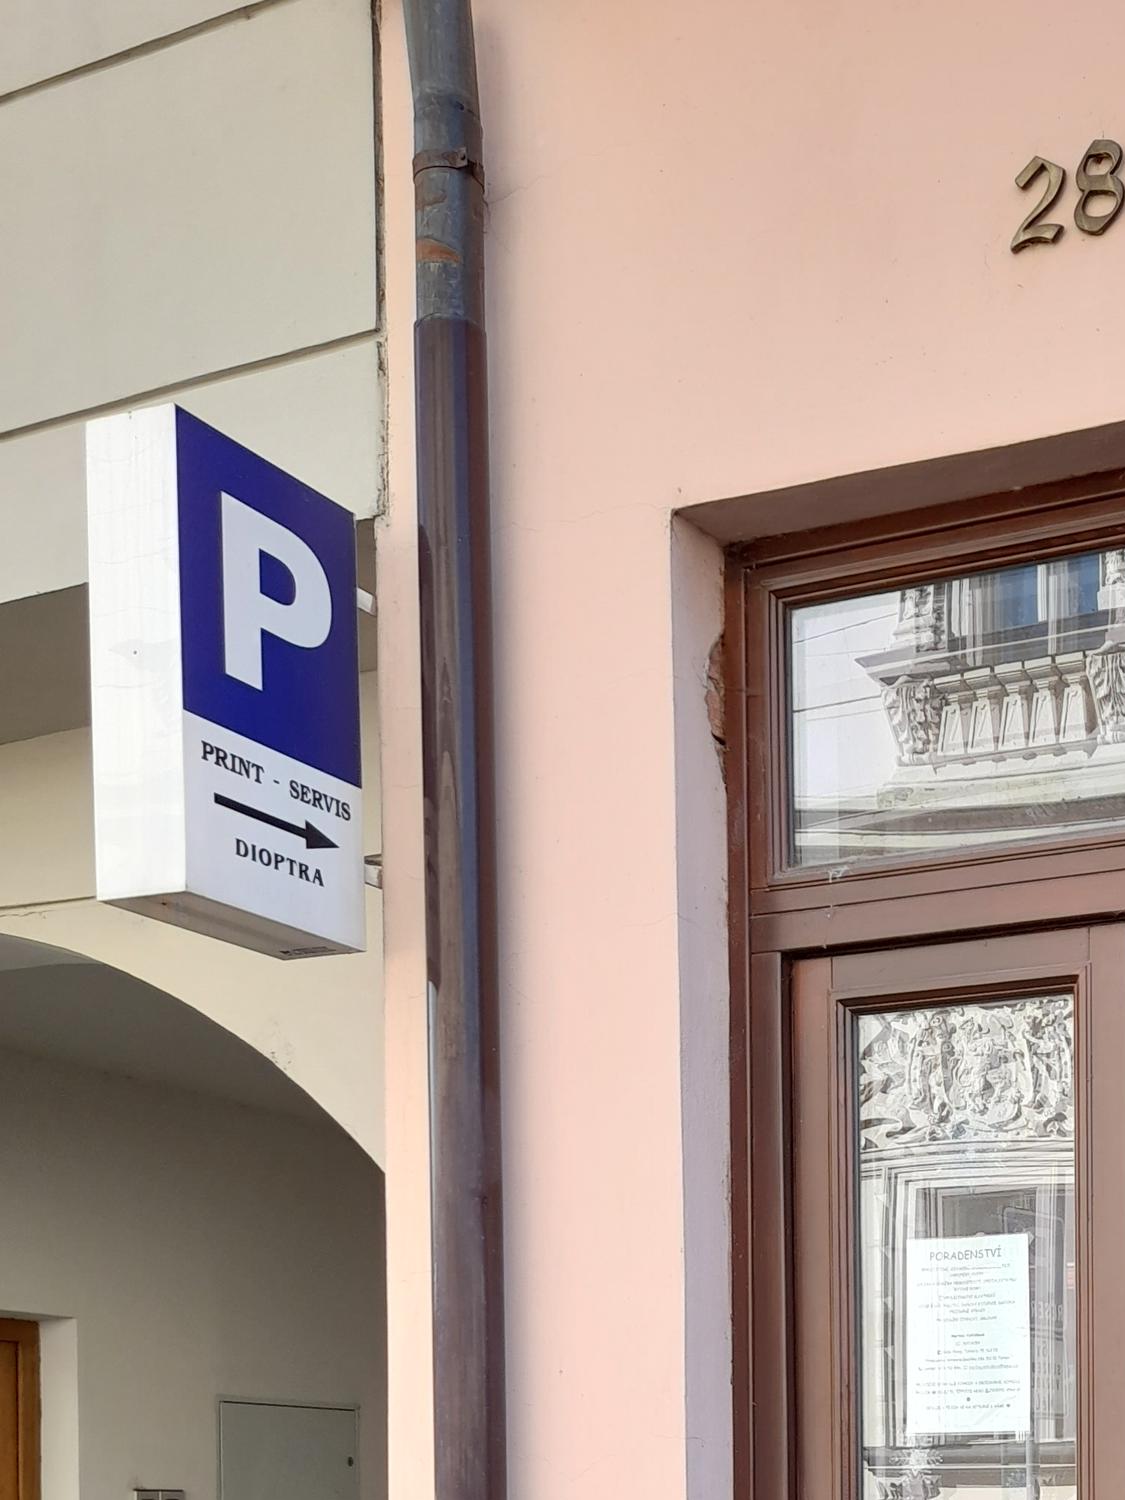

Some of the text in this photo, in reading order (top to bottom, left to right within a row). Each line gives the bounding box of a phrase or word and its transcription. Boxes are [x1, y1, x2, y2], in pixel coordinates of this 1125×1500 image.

[220, 490, 333, 692] P
[201, 740, 265, 784] PRINT
[289, 780, 352, 822] SERVIS
[235, 838, 325, 887] DIOPTRA
